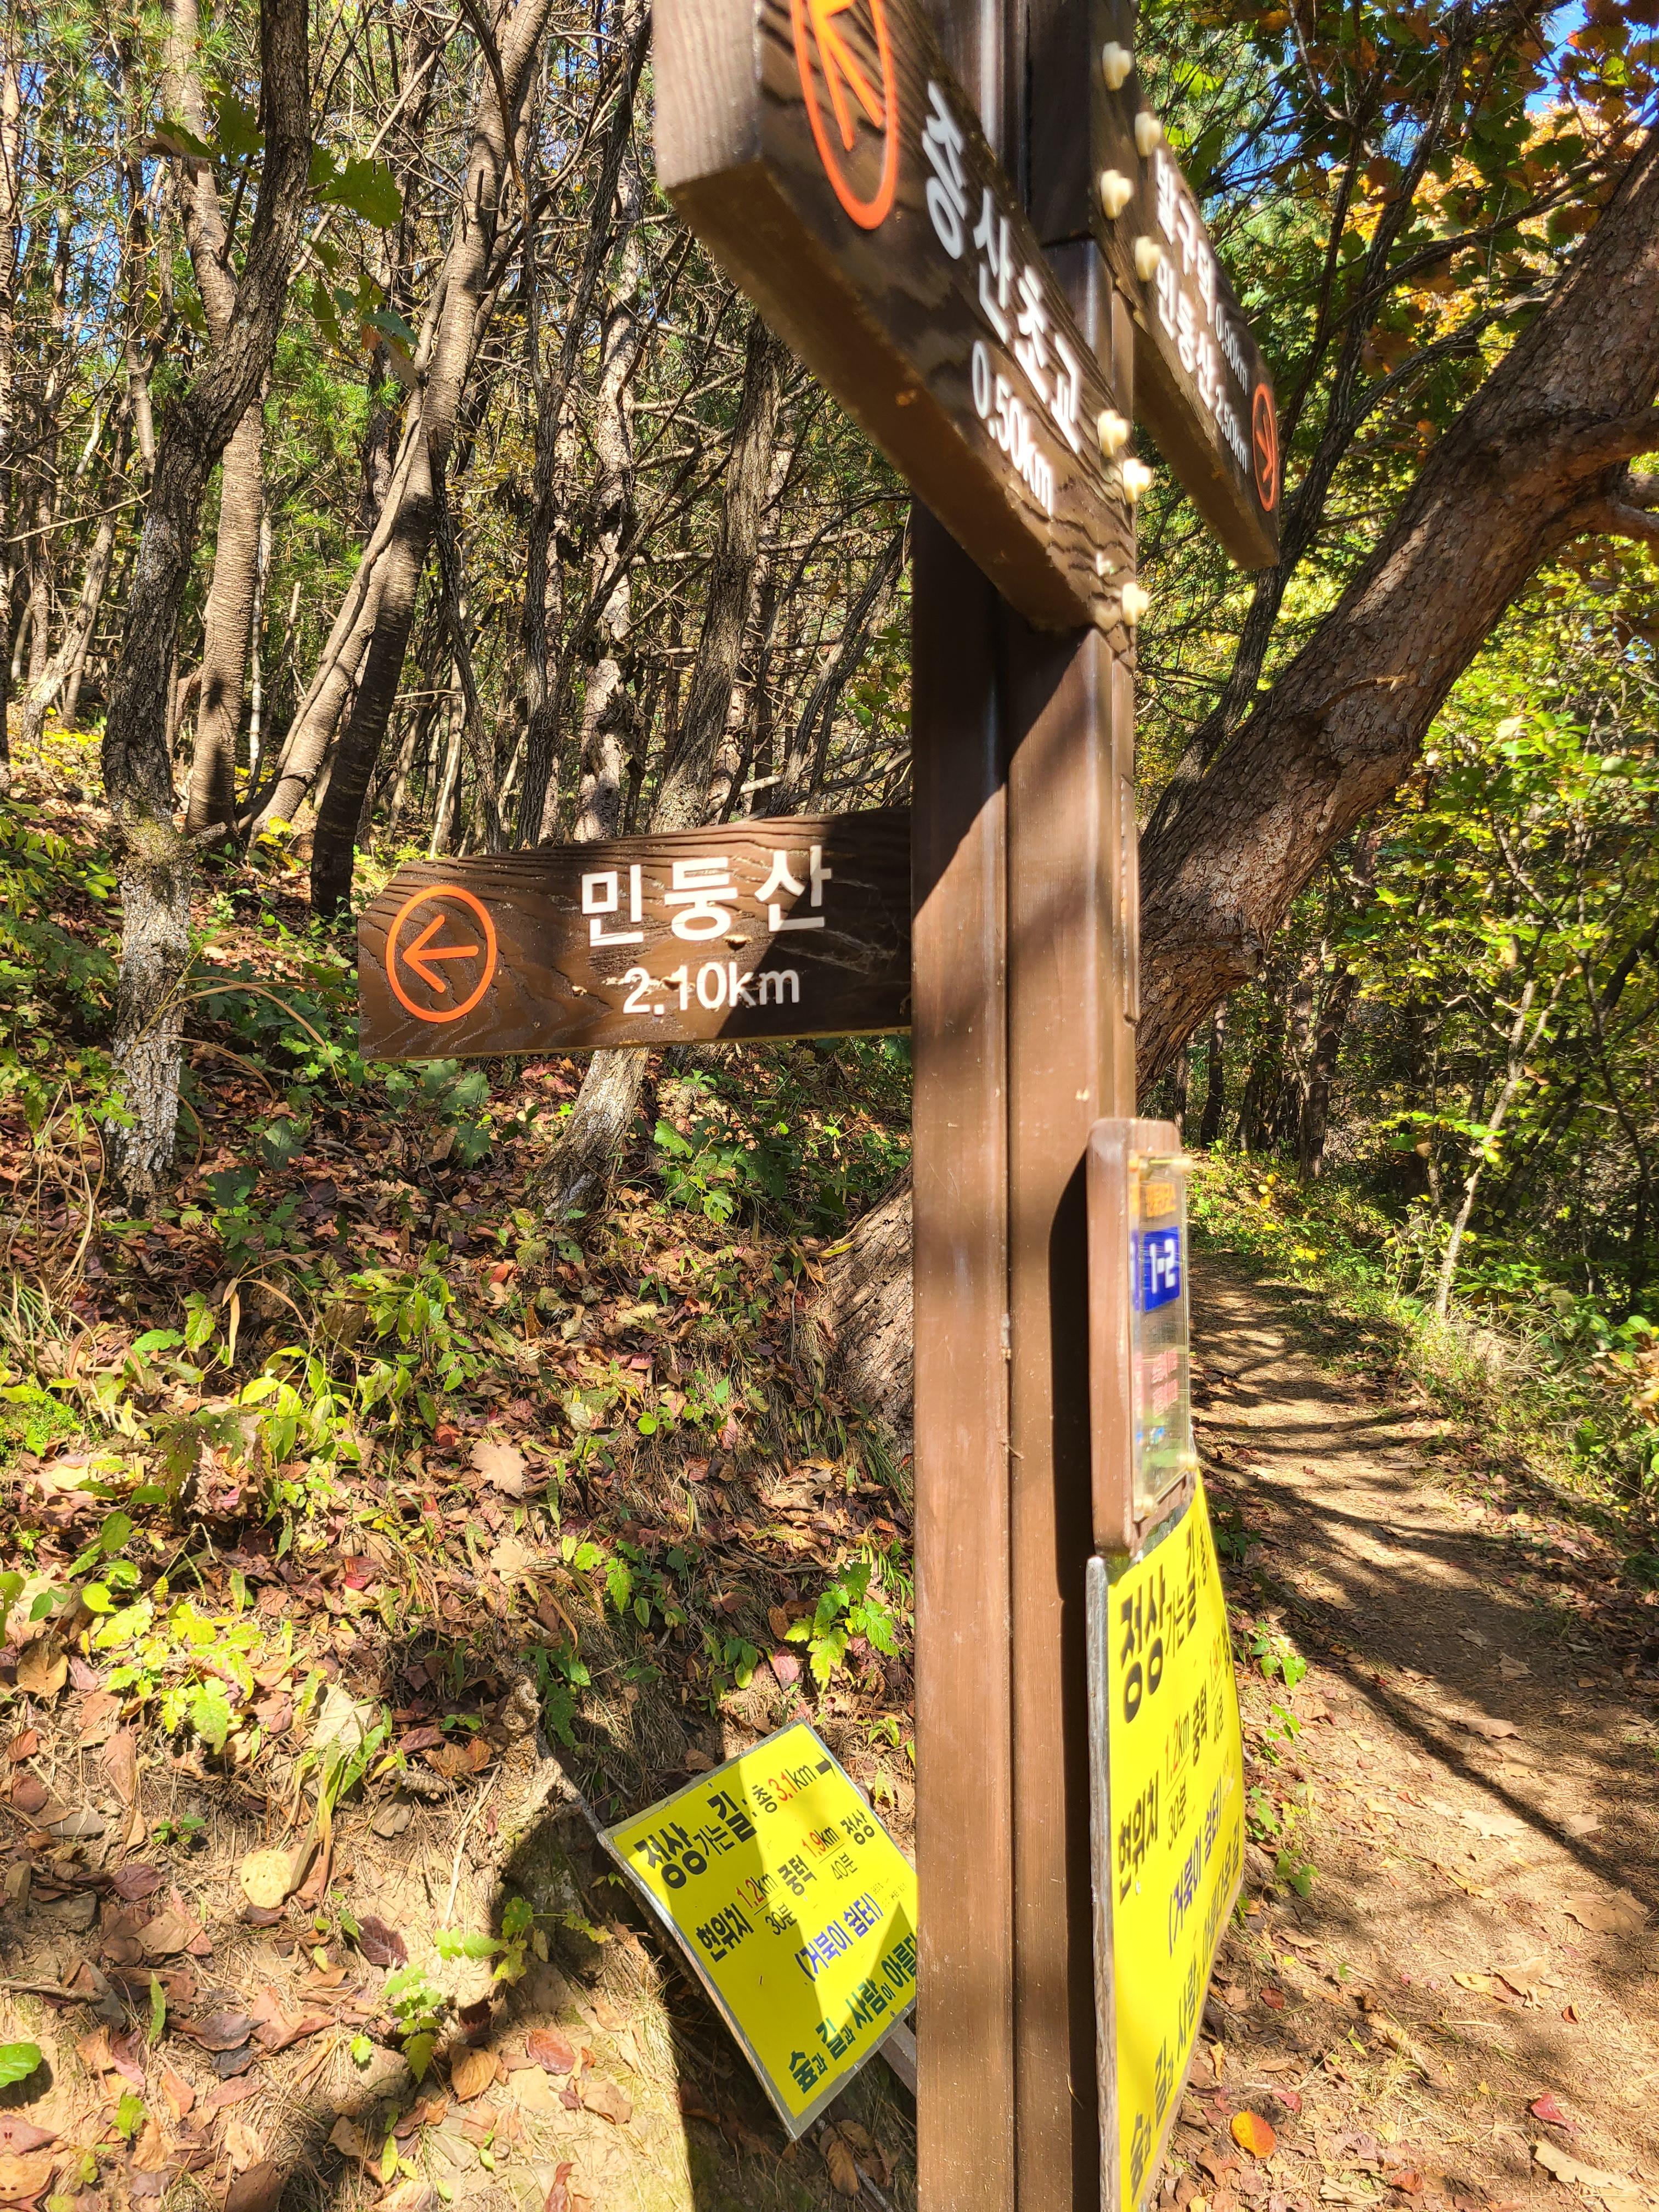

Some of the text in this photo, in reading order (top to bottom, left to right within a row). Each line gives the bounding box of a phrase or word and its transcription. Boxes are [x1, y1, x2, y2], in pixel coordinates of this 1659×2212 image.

[922, 81, 1080, 454] 증산초교
[1155, 148, 1248, 395] 발구덕 0.90km
[1158, 253, 1248, 474] 민둥산 2.50km
[972, 340, 1053, 516] 0.50km
[582, 845, 831, 947] 민둥산
[623, 962, 799, 1016] 2.10km
[801, 1825, 841, 1858] 1.9km
[841, 1810, 876, 1847] 정상
[1118, 1769, 1159, 1905] 현위치
[1167, 1781, 1188, 1850] 30분
[736, 1871, 779, 1909] 1.2km
[777, 1854, 819, 1899] 중턱
[831, 1851, 859, 1882] 40분
[696, 1905, 754, 1963] 현위치
[770, 1903, 798, 1936] 30분
[787, 2050, 828, 2094] 숲과
[815, 2017, 856, 2059] 길과
[851, 1974, 892, 2035] 사람이
